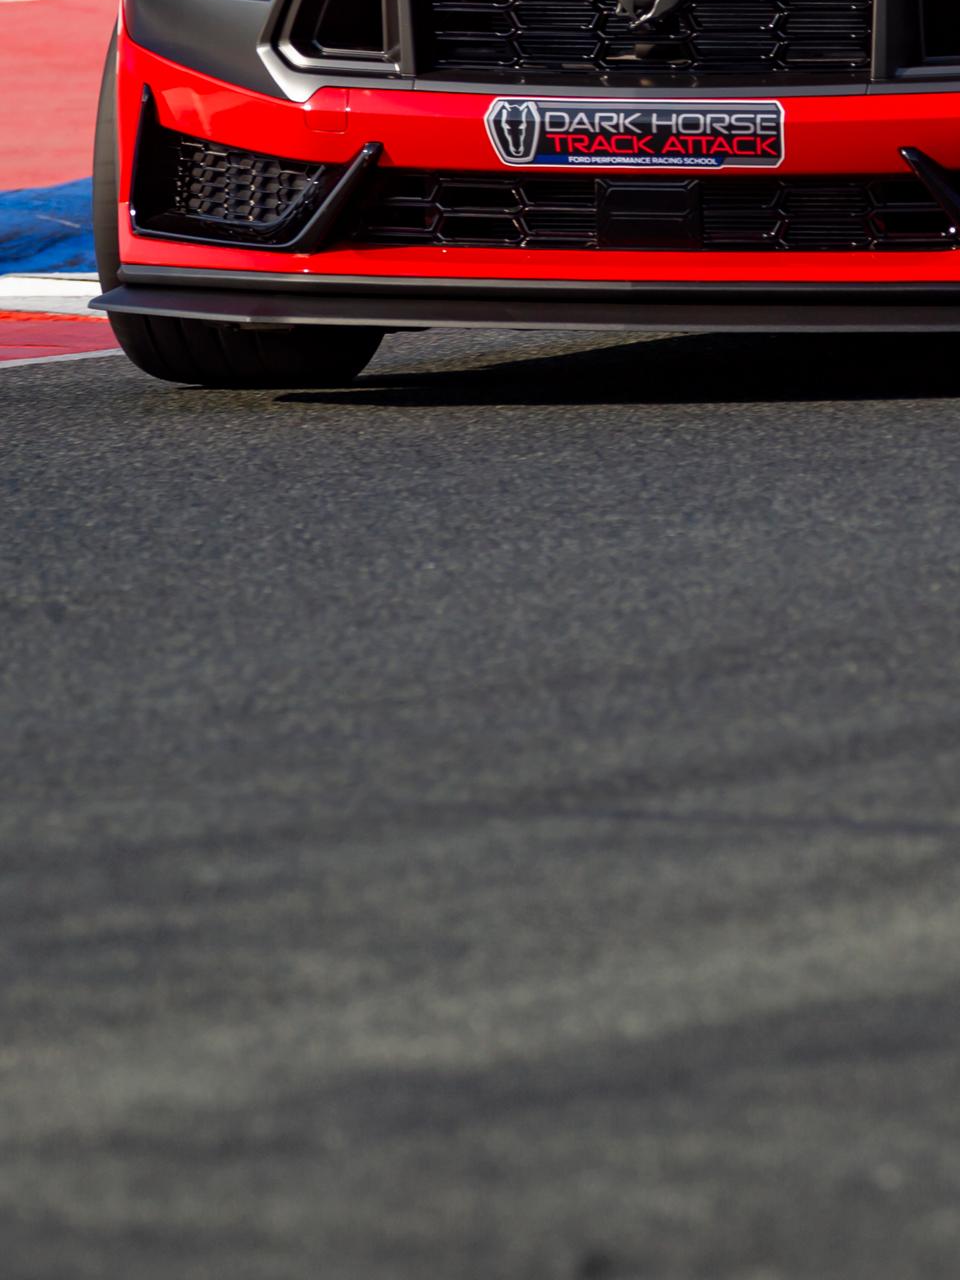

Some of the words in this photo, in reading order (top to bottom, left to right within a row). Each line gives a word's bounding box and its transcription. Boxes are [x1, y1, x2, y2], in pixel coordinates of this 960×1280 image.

[544, 111, 642, 134] DARK
[651, 112, 778, 135] HORSE
[545, 133, 655, 155] TRACK
[661, 135, 778, 156] ATTACK
[568, 156, 591, 164] FORD
[591, 156, 651, 165] PERFORMANCE
[651, 156, 683, 165] RACING
[683, 157, 719, 166] SCHOOL
